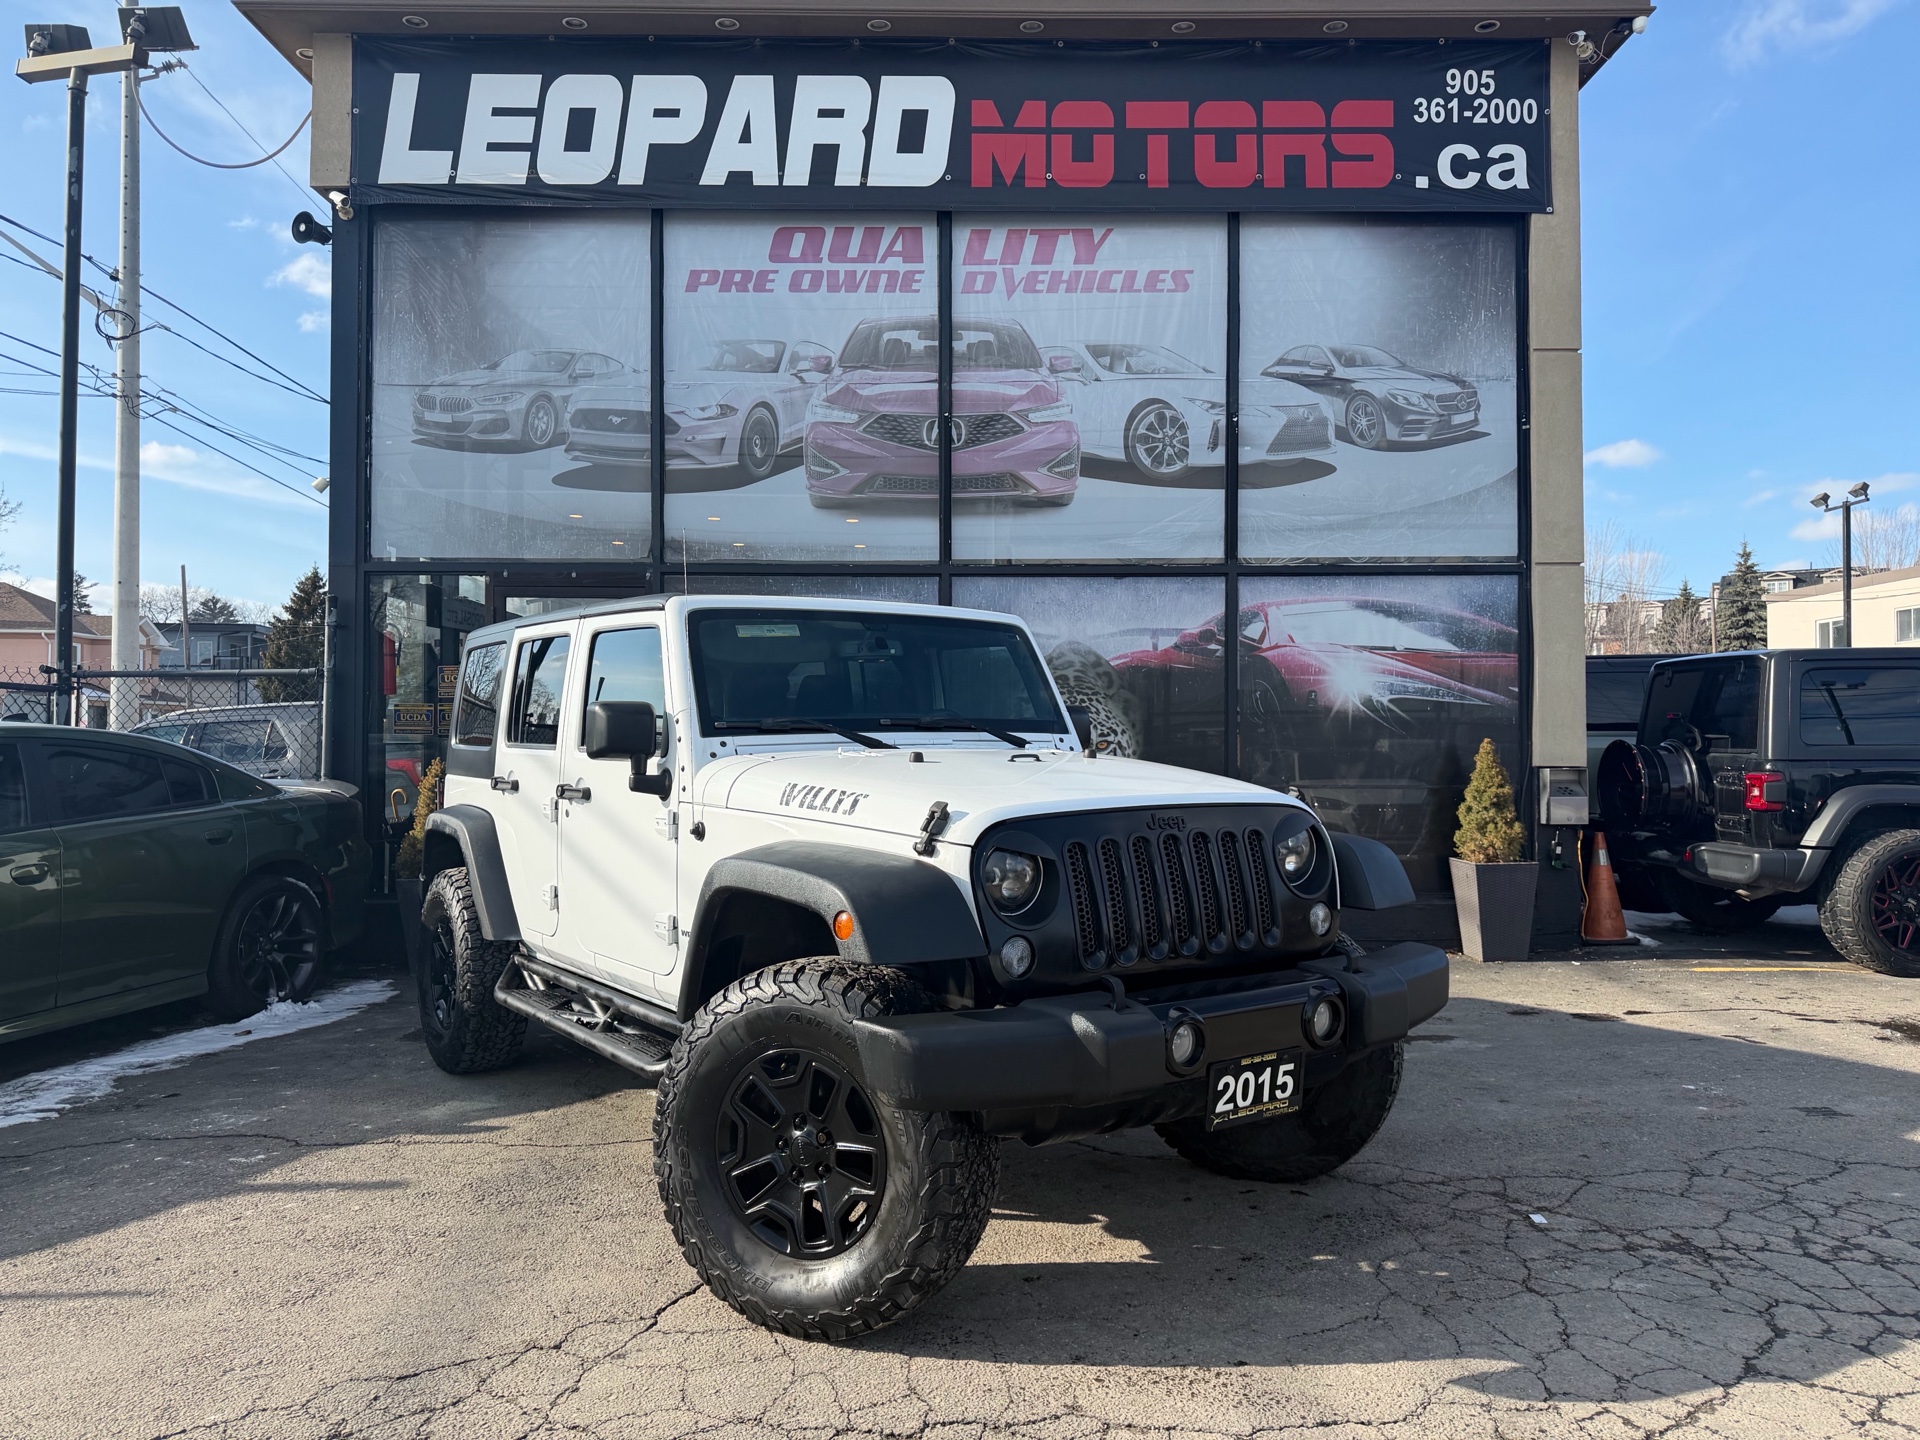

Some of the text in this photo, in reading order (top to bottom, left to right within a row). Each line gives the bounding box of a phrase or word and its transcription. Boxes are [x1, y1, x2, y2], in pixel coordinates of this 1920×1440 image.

[1445, 68, 1496, 96] 905
[1413, 97, 1538, 125] 361-2000
[378, 72, 1395, 189] LEOPARD MOTORS
[1415, 143, 1531, 190] .ca
[685, 269, 775, 293] PRE
[399, 713, 428, 721] UCDA
[1146, 812, 1187, 832] Jeep
[1215, 1062, 1295, 1114] 2015
[1229, 1099, 1289, 1119] LEOPARD
